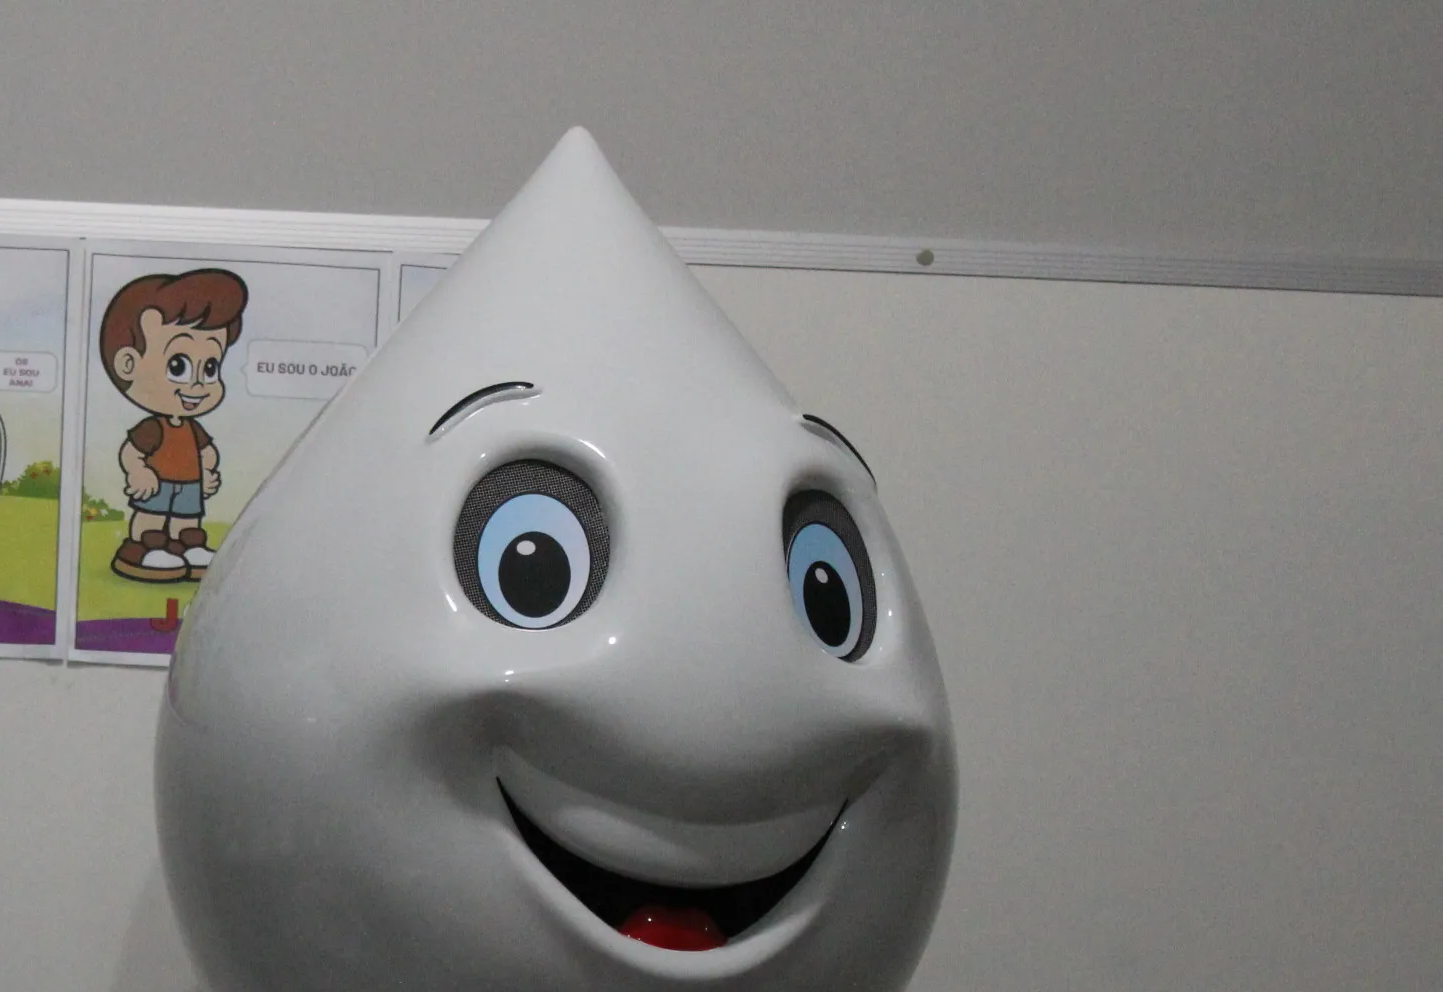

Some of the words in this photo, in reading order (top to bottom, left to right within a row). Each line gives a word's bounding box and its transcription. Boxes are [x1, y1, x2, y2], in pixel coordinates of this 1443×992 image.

[3, 368, 17, 377] EU
[19, 368, 40, 377] SOU
[257, 361, 274, 374] EU
[278, 362, 305, 376] SOU
[308, 364, 318, 376] O
